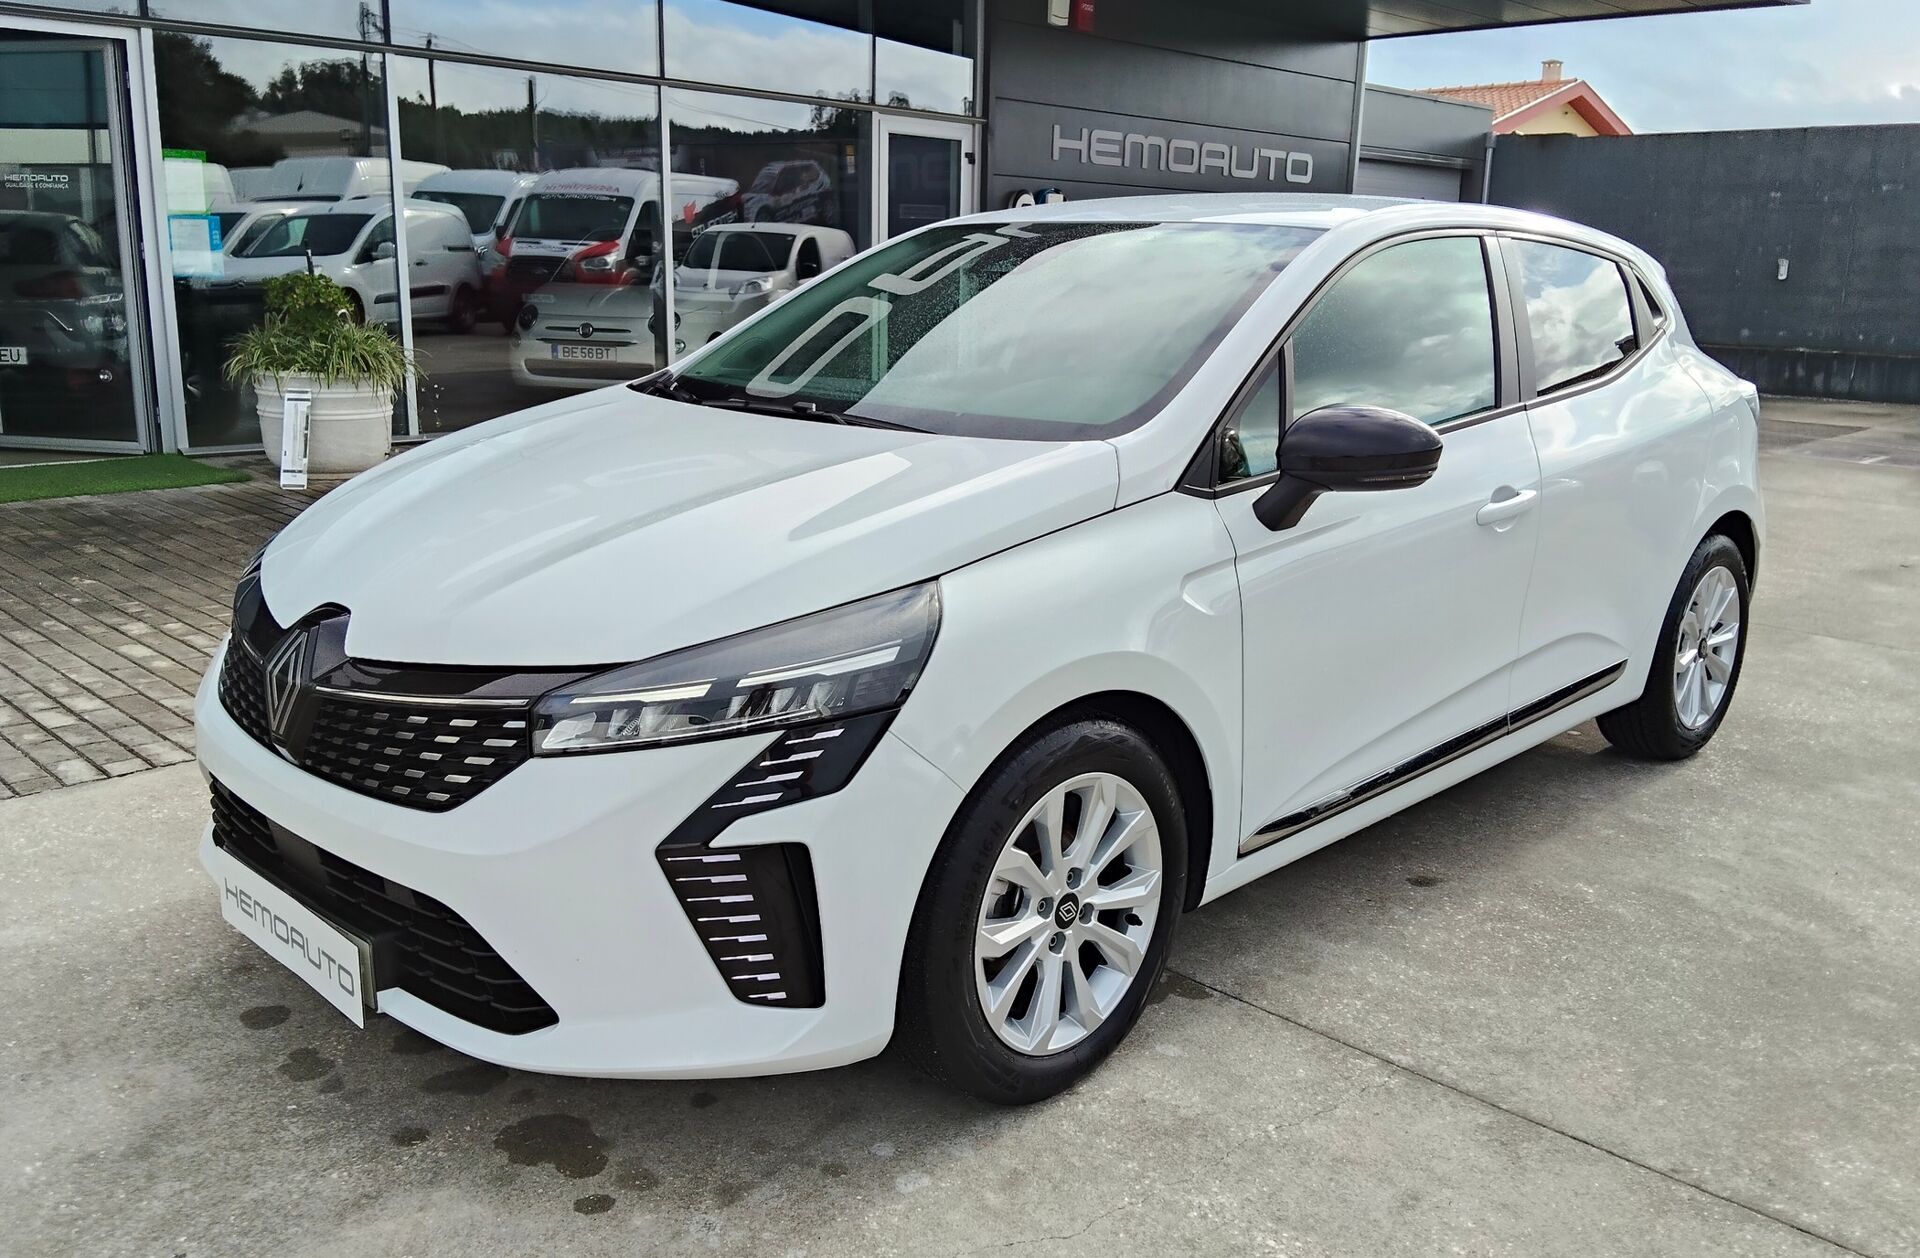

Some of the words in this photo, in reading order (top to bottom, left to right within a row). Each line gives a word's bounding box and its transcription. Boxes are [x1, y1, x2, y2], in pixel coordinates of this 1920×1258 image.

[4, 174, 69, 182] HEMOAUTO
[1051, 124, 1314, 184] HEMOAUTO
[224, 877, 357, 998] HEMOAUTO
